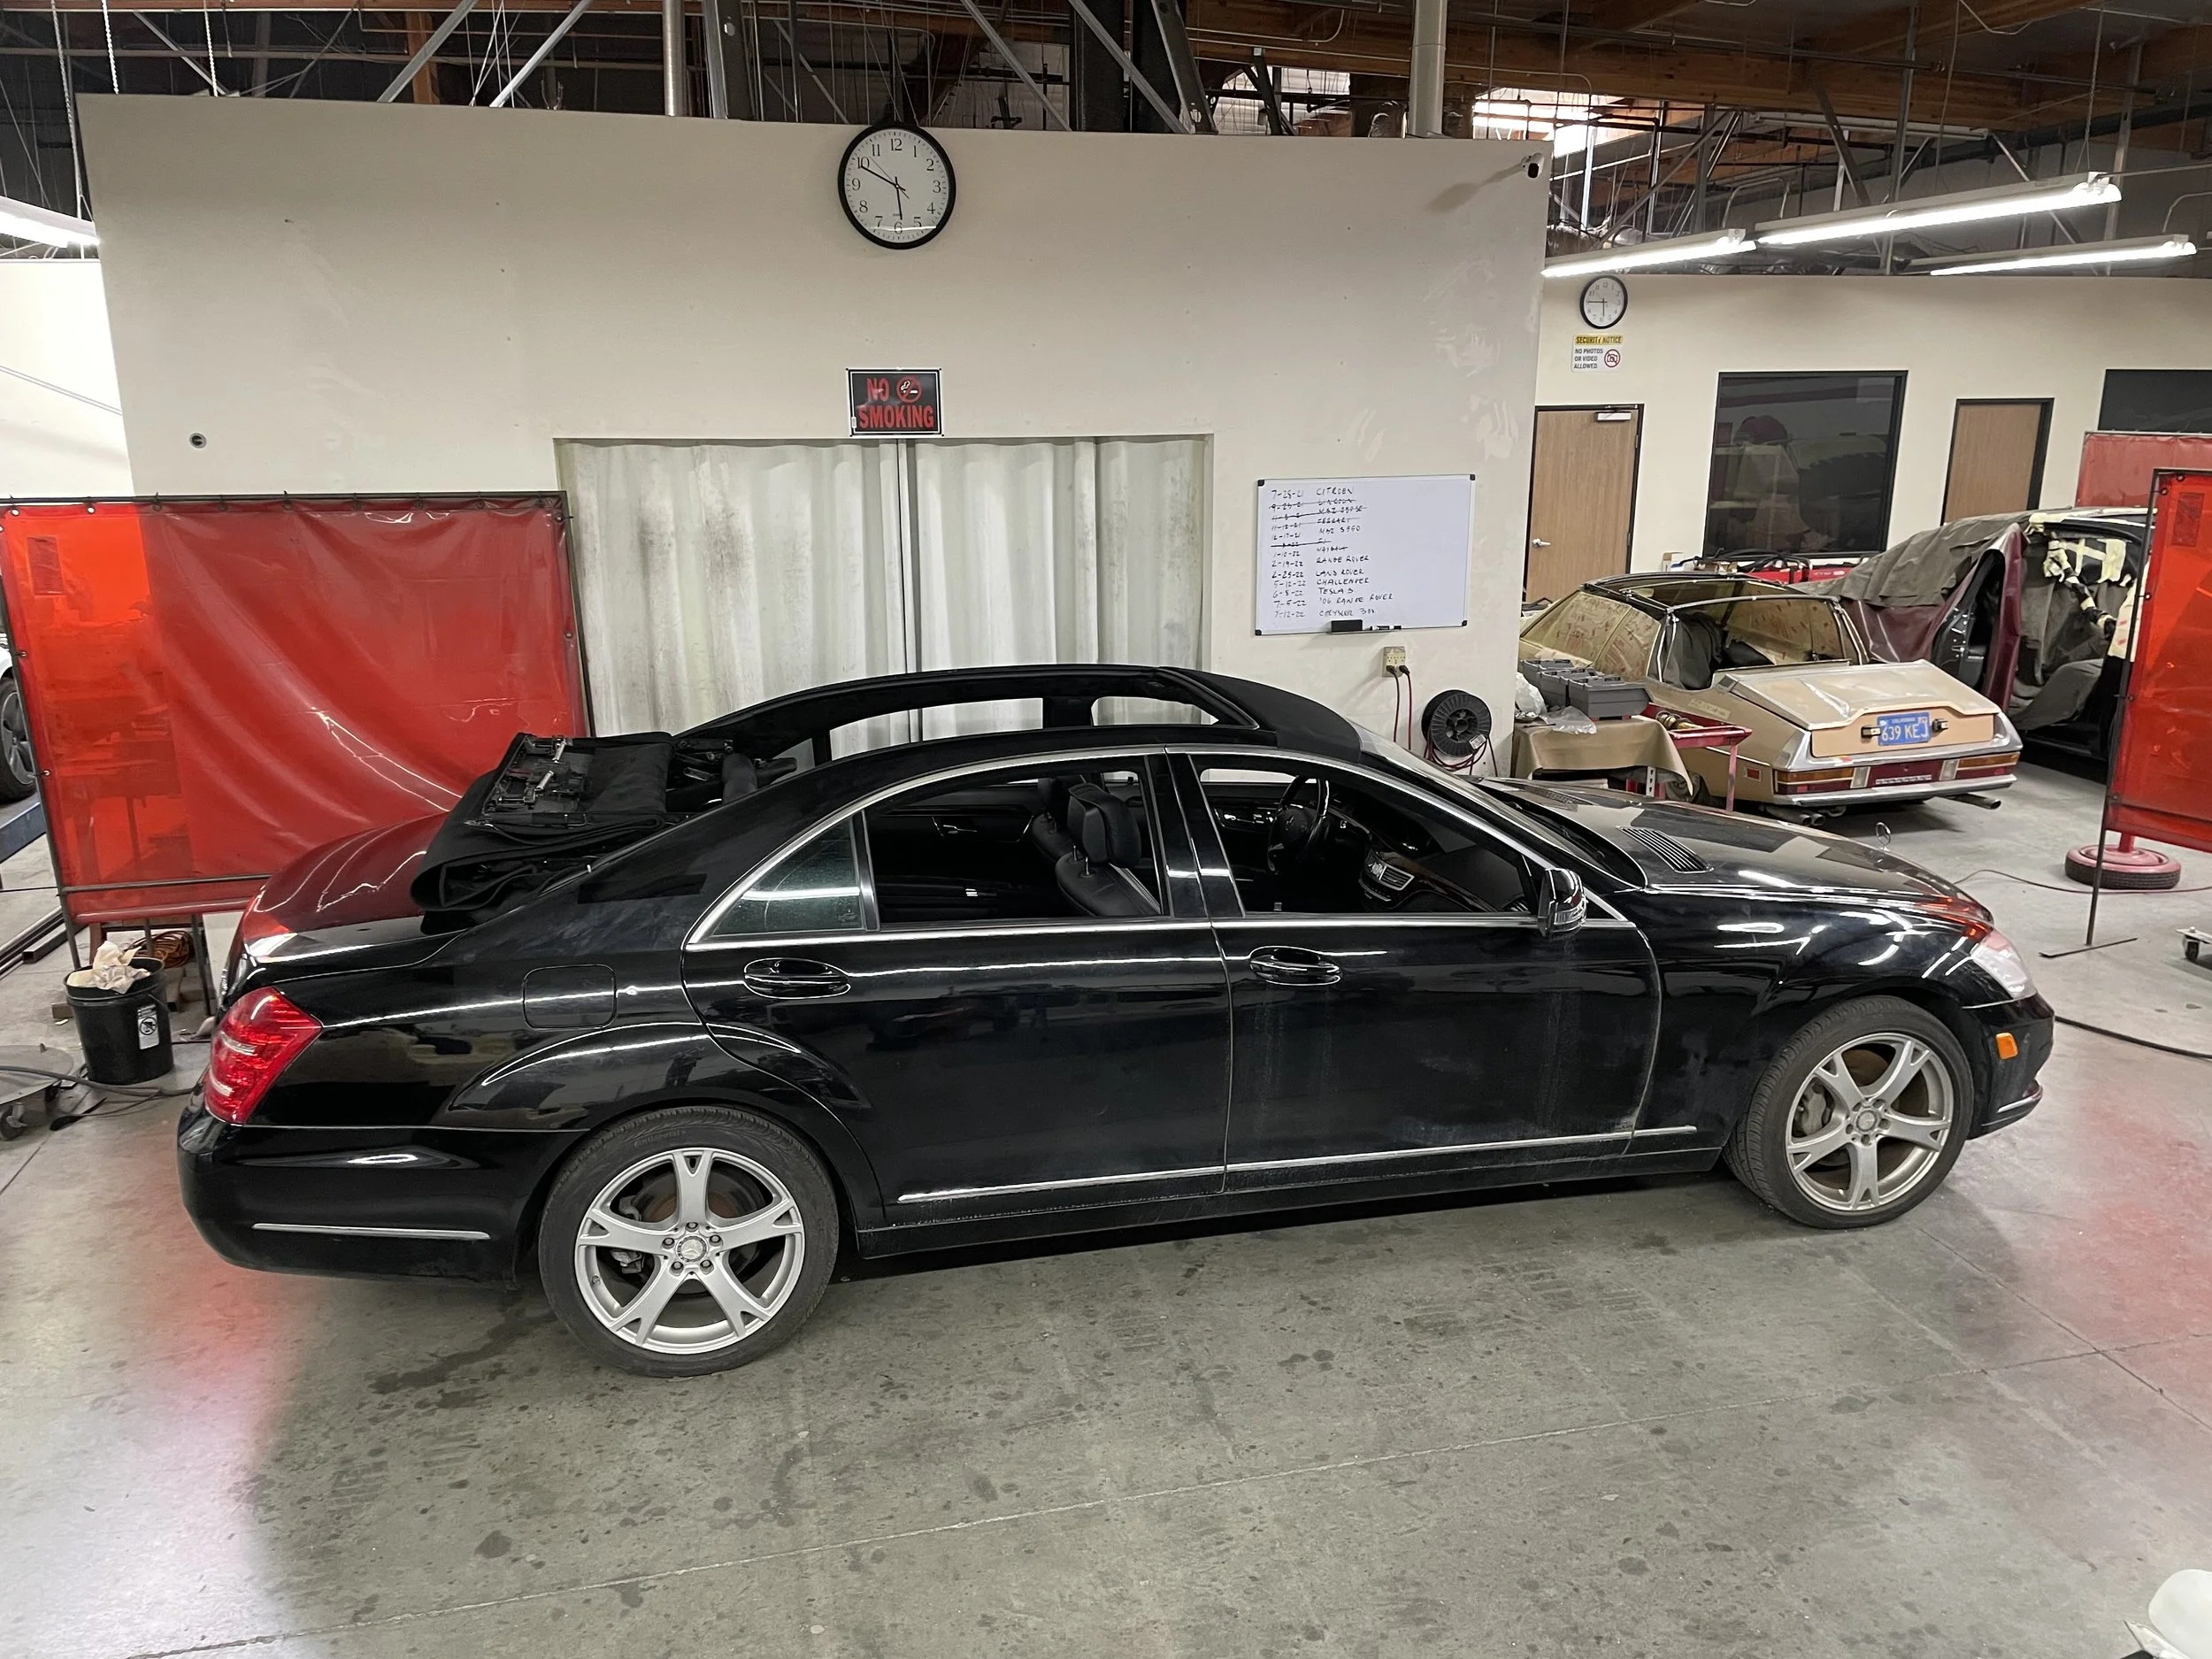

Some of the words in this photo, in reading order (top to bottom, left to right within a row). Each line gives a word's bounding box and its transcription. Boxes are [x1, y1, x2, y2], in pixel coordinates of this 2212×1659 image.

[872, 143, 881, 157] 11
[890, 138, 902, 151] 12
[913, 144, 918, 157] 1
[857, 156, 870, 169] 10
[926, 157, 934, 171] 2
[851, 177, 861, 191] 9
[933, 180, 941, 193] 3
[858, 199, 869, 213] 8
[926, 201, 936, 214] 4
[874, 215, 883, 227] 7
[894, 221, 902, 234] 6
[913, 216, 922, 228] 5
[1576, 335, 1601, 344] SECURITY
[1602, 335, 1622, 344] NOTICE
[866, 377, 890, 402] NO
[859, 403, 934, 429] SMOKING
[1316, 487, 1354, 495] CITROEN
[1317, 577, 1371, 586] CHALLENGER
[1881, 725, 1901, 741] 639
